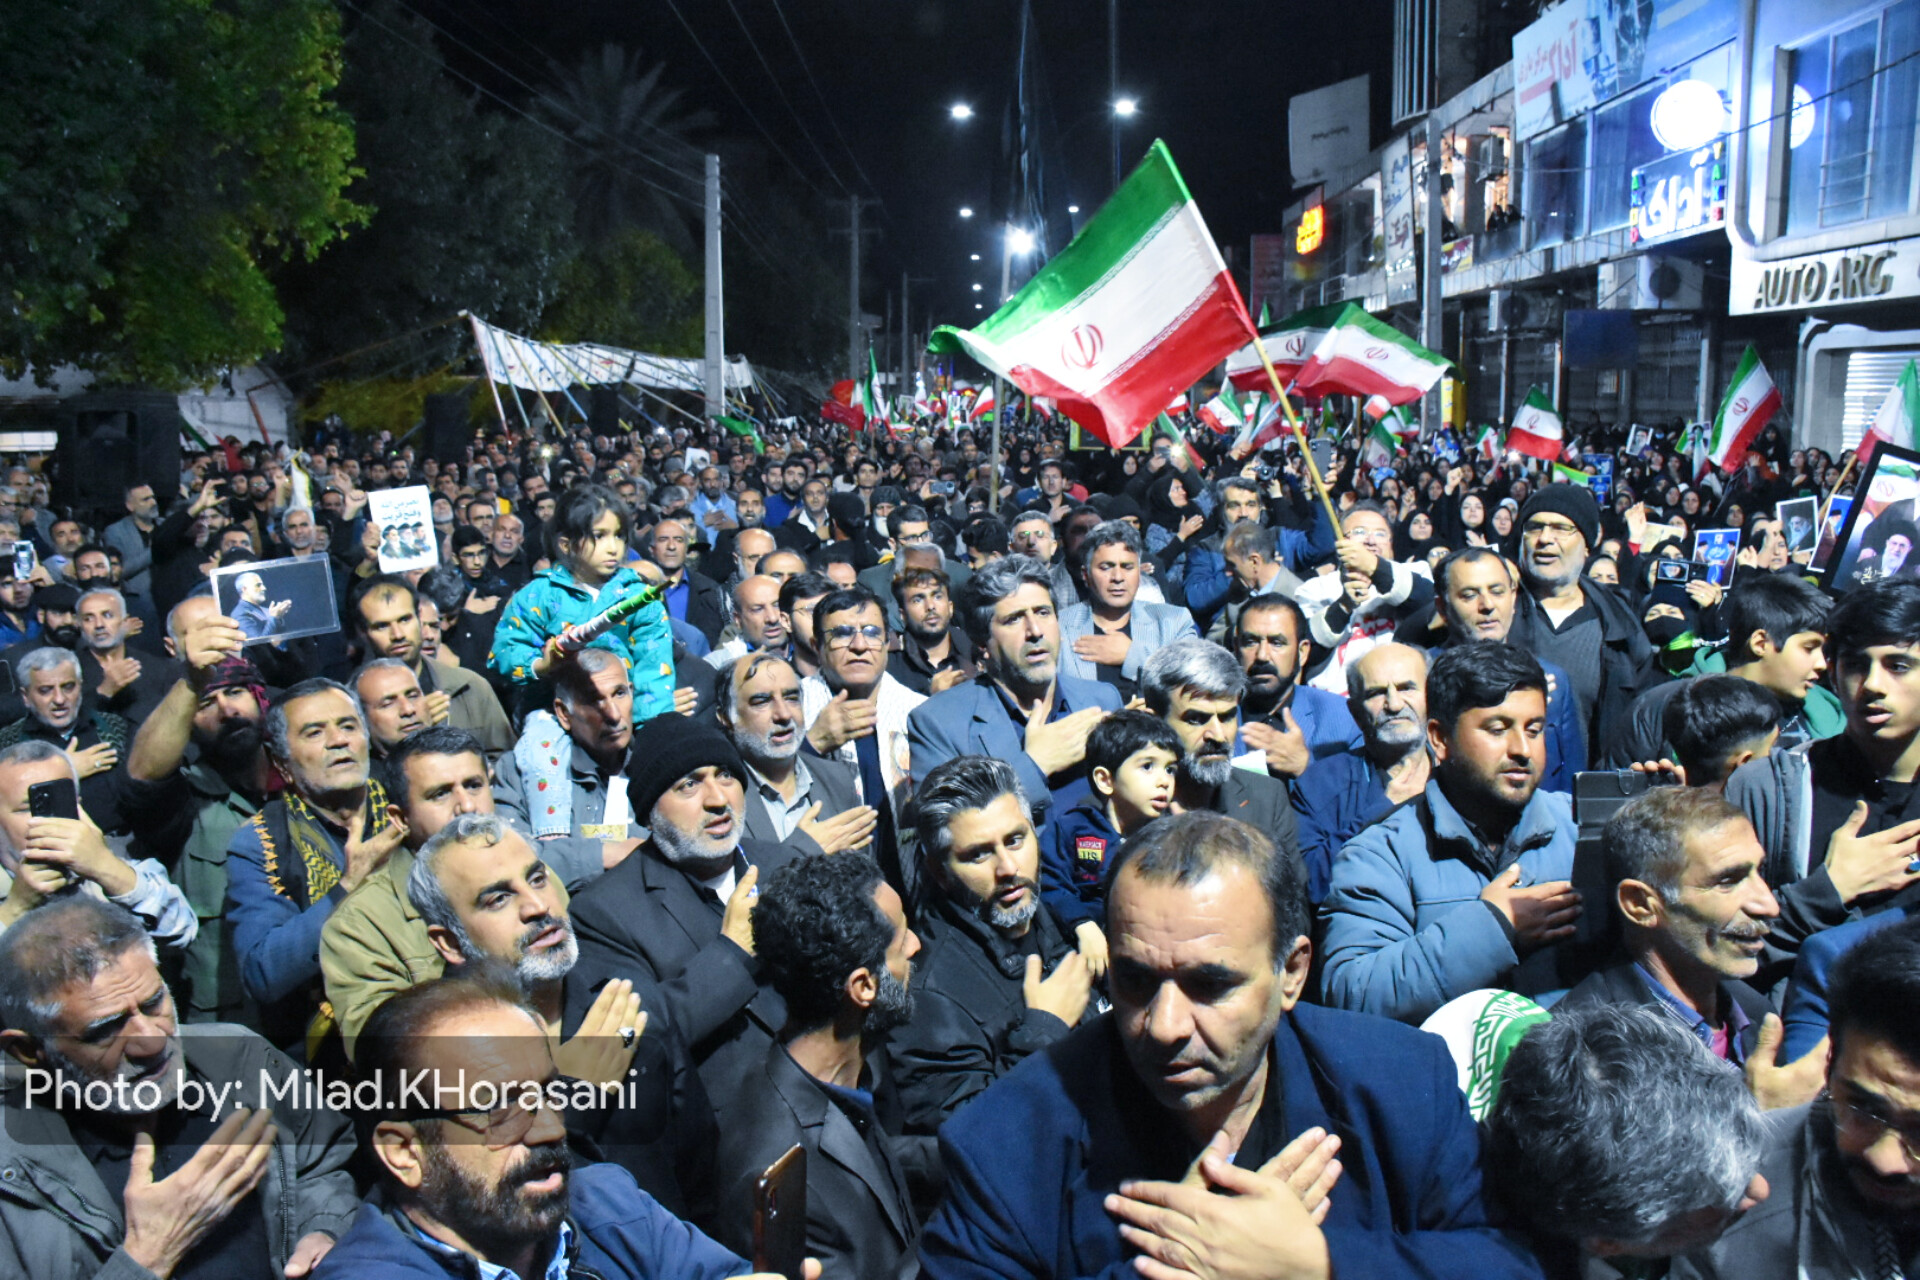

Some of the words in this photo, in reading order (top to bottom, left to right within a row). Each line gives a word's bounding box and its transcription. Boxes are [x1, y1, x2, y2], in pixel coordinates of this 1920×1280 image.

[1639, 147, 1710, 240] آداک
[1753, 260, 1828, 309] AUTO
[1828, 250, 1898, 301] ARG
